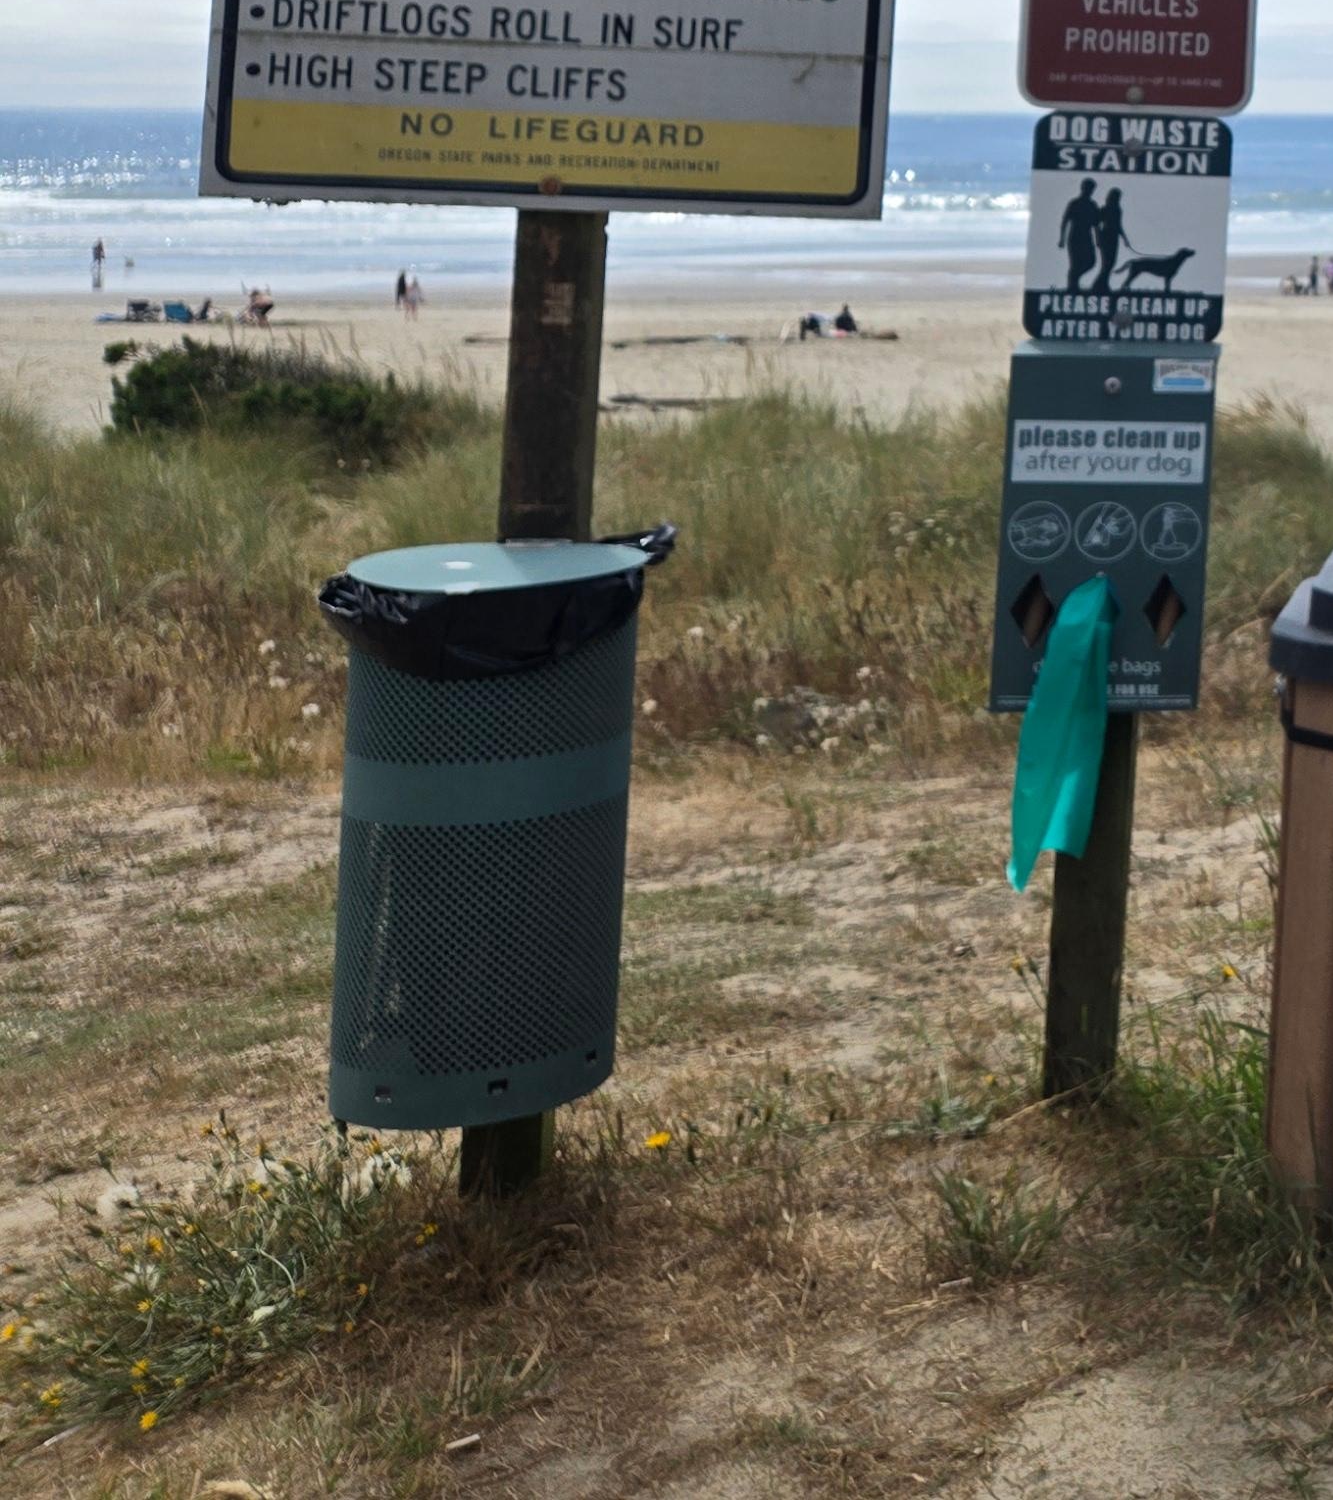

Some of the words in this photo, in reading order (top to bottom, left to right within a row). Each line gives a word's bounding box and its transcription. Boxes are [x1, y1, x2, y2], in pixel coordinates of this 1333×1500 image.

[489, 8, 581, 45] ROLL
[601, 13, 635, 47] IN
[653, 16, 744, 52] SURF
[1065, 27, 1210, 58] PROHIBITED
[267, 53, 354, 91] HIGH
[373, 57, 488, 97] STEEP
[506, 64, 628, 103] CLIFFS
[399, 111, 454, 137] NO
[488, 115, 705, 148] LIFEGUARD
[1050, 115, 1109, 143] DOG
[1119, 117, 1219, 147] WASTE
[378, 148, 431, 163] OREGON
[439, 150, 474, 164] STATE
[481, 151, 522, 166] PARKS
[528, 153, 551, 167] AND
[559, 155, 635, 170] RECREATION
[642, 158, 721, 173] DEPARTMENT
[1039, 293, 1109, 314] PLEASE
[1116, 296, 1177, 316] CLEAN
[1184, 298, 1210, 317] UP
[1041, 319, 1101, 338] AFTER
[1165, 323, 1206, 340] DOG
[1019, 425, 1097, 449] please
[1103, 427, 1167, 449] clean
[1173, 430, 1201, 451] up
[1025, 449, 1081, 471] after
[1087, 454, 1140, 476] your
[1145, 452, 1193, 477] dog
[1121, 657, 1162, 677] bags
